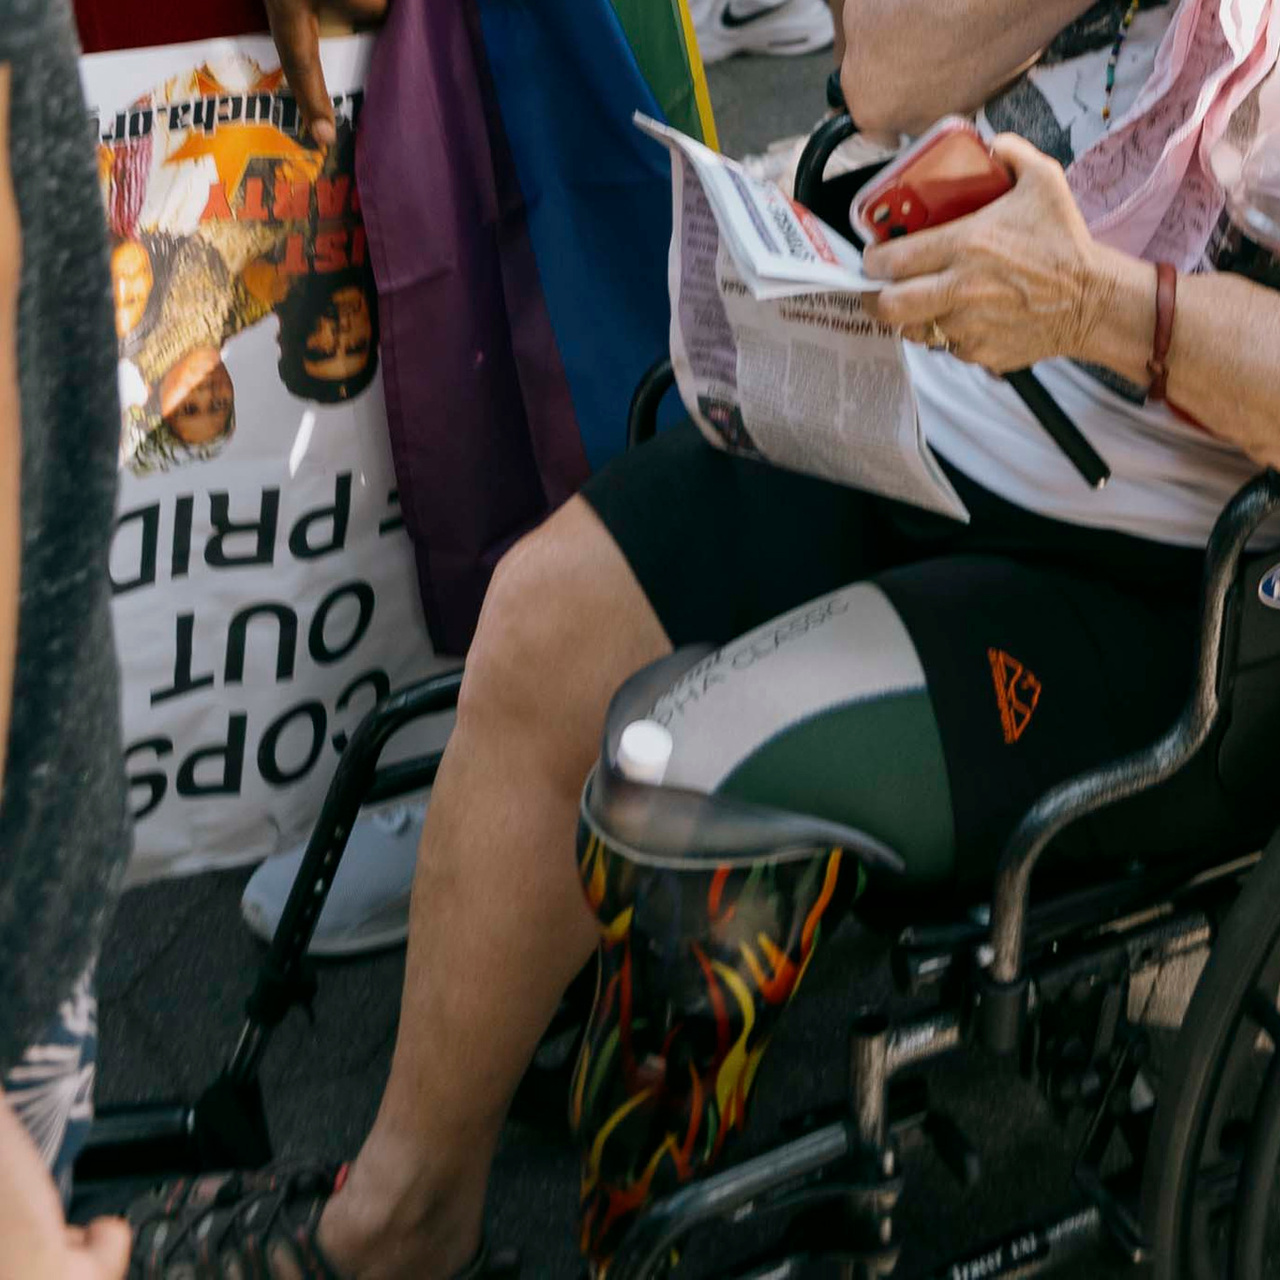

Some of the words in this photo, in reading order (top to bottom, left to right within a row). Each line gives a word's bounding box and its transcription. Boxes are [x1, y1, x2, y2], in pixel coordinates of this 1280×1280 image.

[200, 174, 361, 225] ARTY
[150, 581, 376, 704] OUT
[125, 667, 391, 821] COPS
